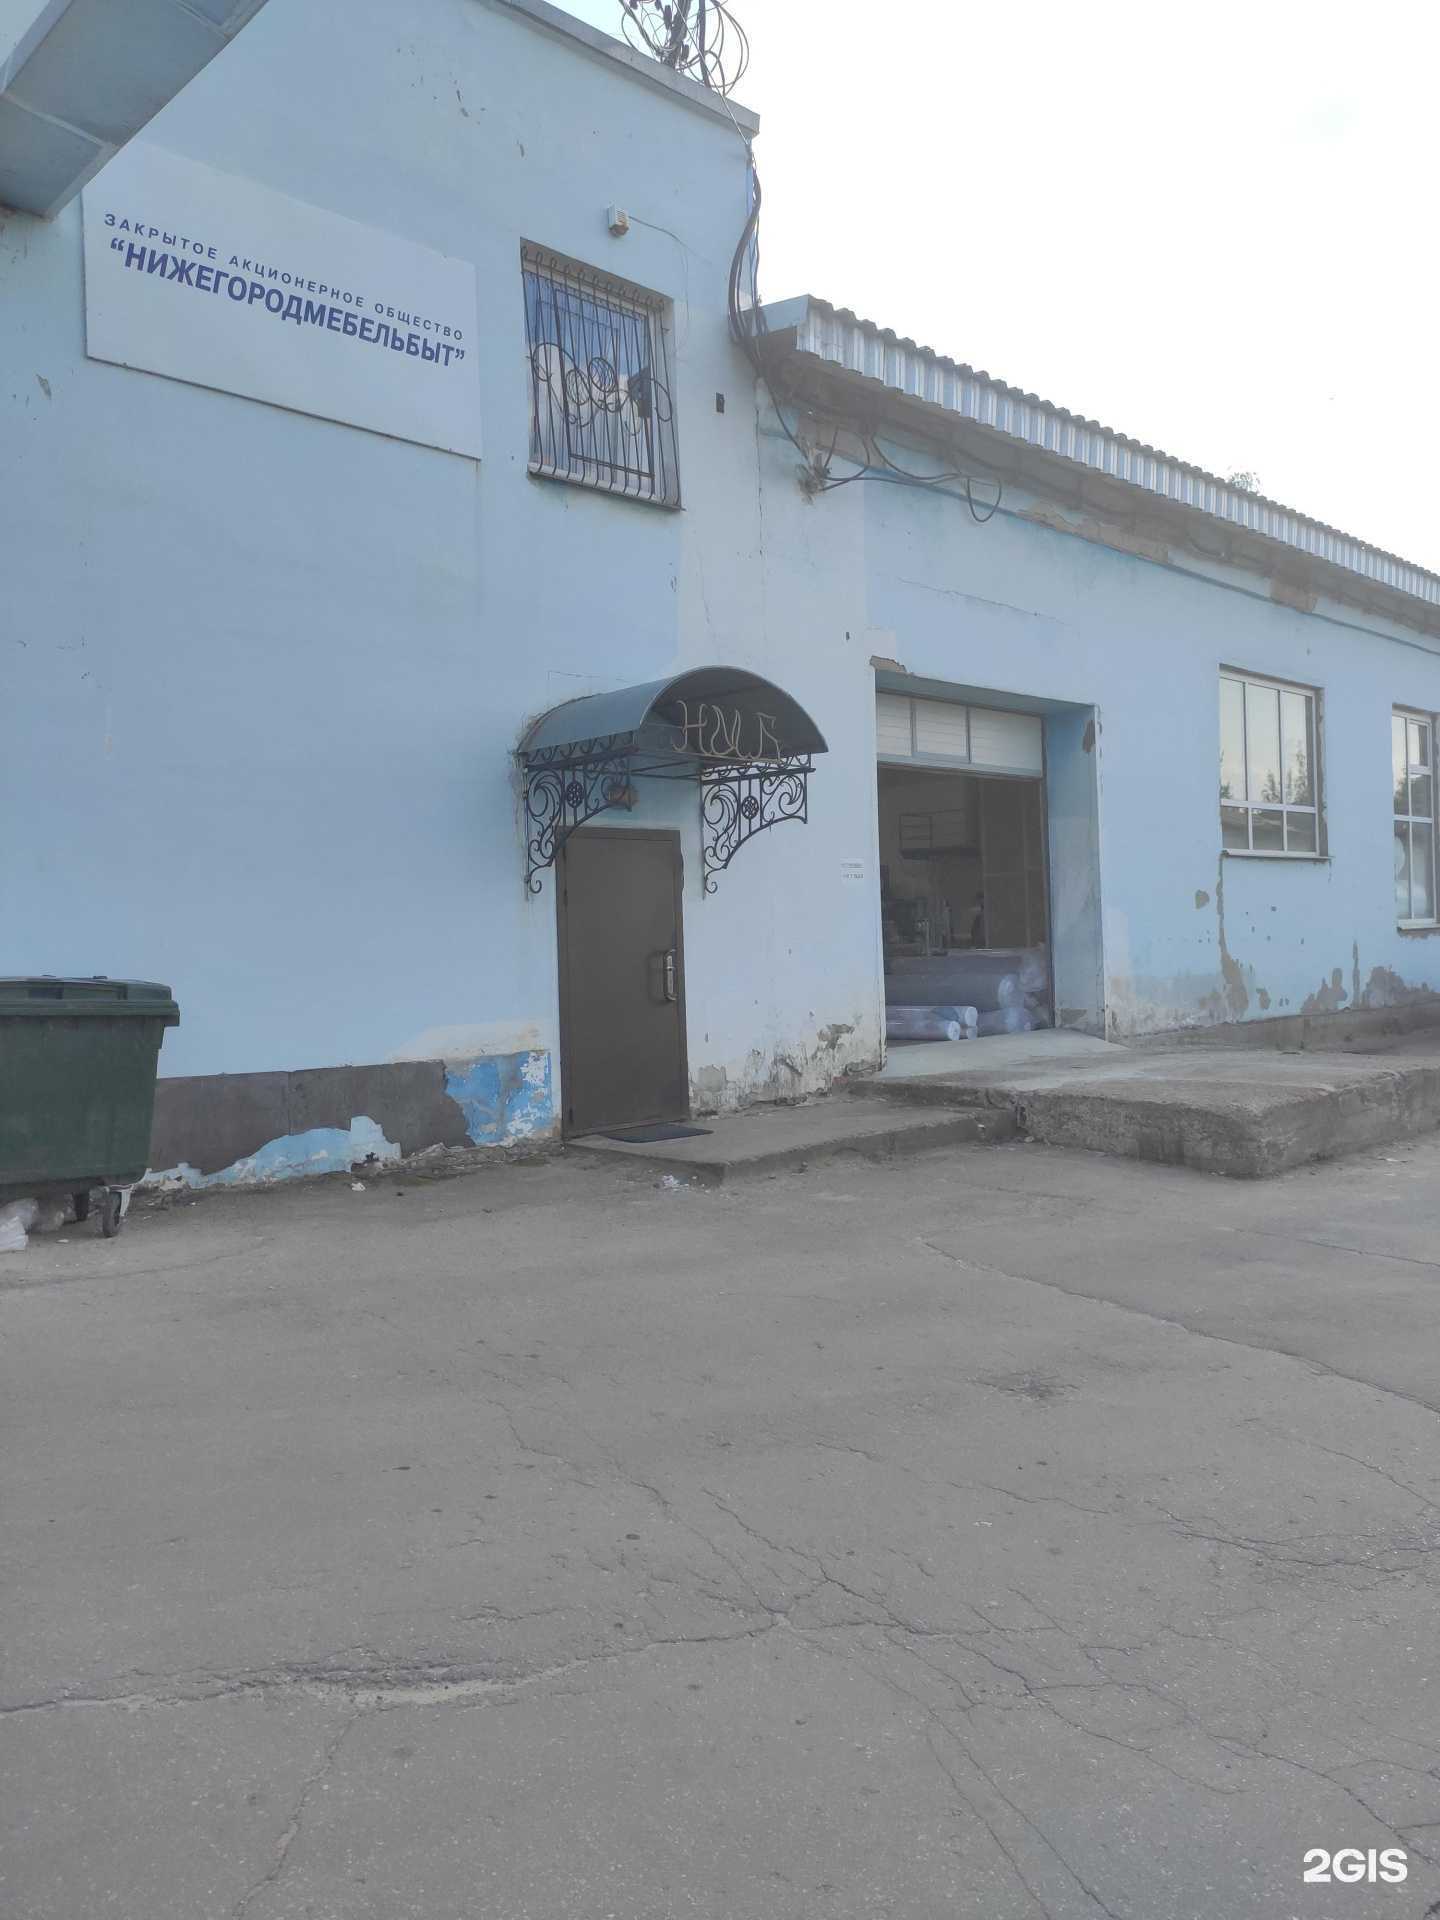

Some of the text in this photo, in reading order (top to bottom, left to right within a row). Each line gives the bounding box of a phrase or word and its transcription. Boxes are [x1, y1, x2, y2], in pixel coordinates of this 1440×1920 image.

[104, 213, 464, 341] ЗАКРЫТОЕ АКЦИОНЕРНОЕ ОБЩЕСТВО
